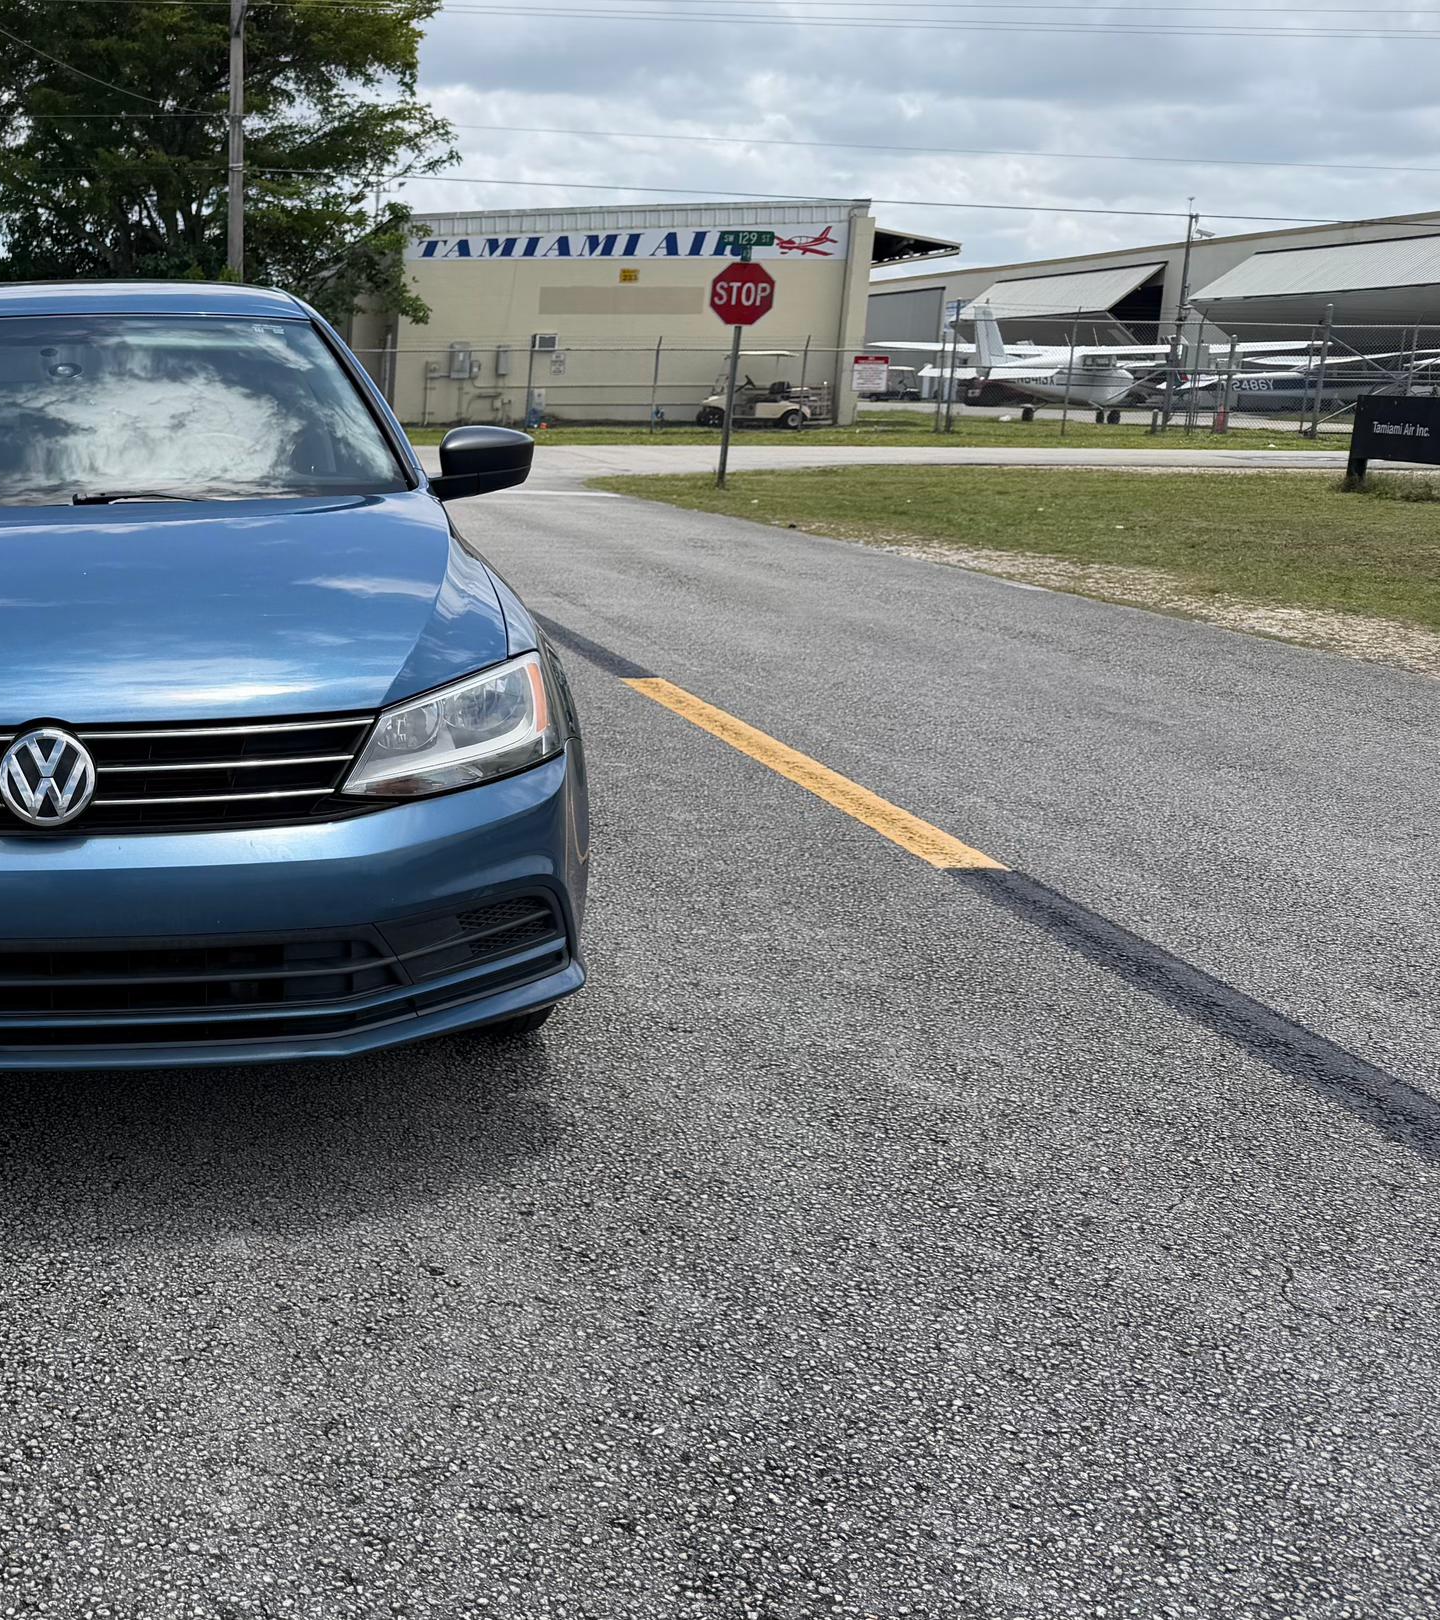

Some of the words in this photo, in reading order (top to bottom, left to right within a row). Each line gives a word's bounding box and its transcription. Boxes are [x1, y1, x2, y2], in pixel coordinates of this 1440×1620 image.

[417, 234, 644, 258] TAMIAMI
[739, 231, 758, 245] 129
[713, 281, 771, 306] STOP
[1372, 421, 1403, 435] Tamiami
[1403, 423, 1415, 436] Air
[1416, 424, 1430, 437] Inc.
